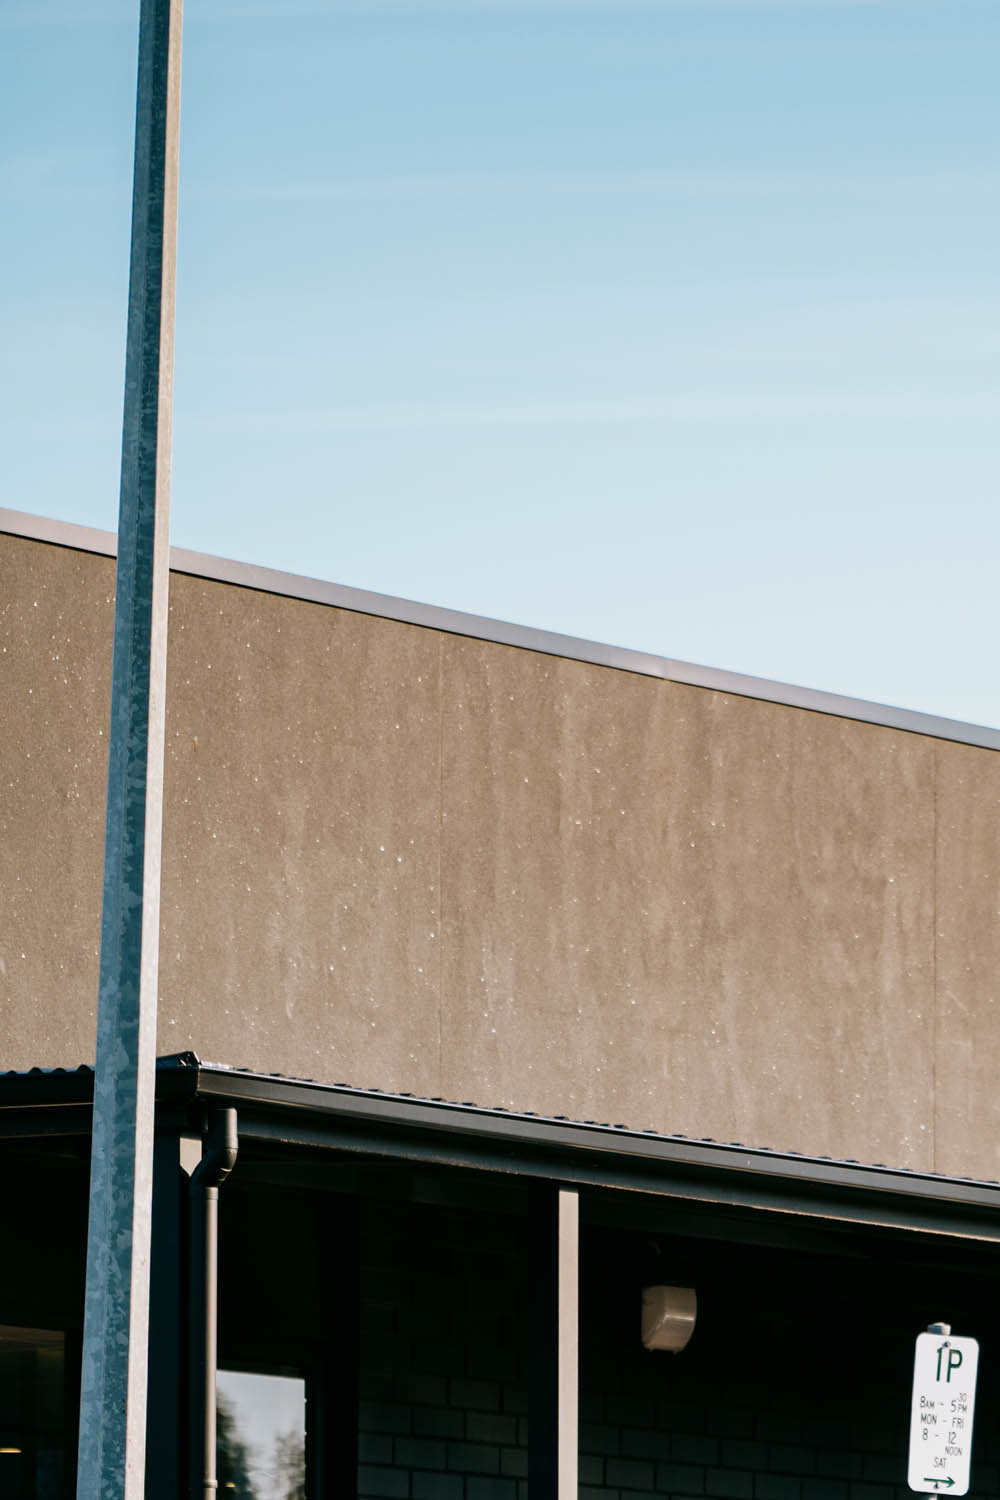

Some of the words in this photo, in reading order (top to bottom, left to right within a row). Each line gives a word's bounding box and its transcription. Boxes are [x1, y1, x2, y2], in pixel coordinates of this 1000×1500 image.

[936, 1347, 963, 1382] 1P
[920, 1395, 935, 1409] 8AM
[920, 1413, 937, 1425] MON
[951, 1417, 964, 1429] FRI
[922, 1428, 928, 1441] 8
[948, 1431, 957, 1445] 12
[945, 1446, 963, 1456] NOON
[933, 1456, 947, 1468] SAT
